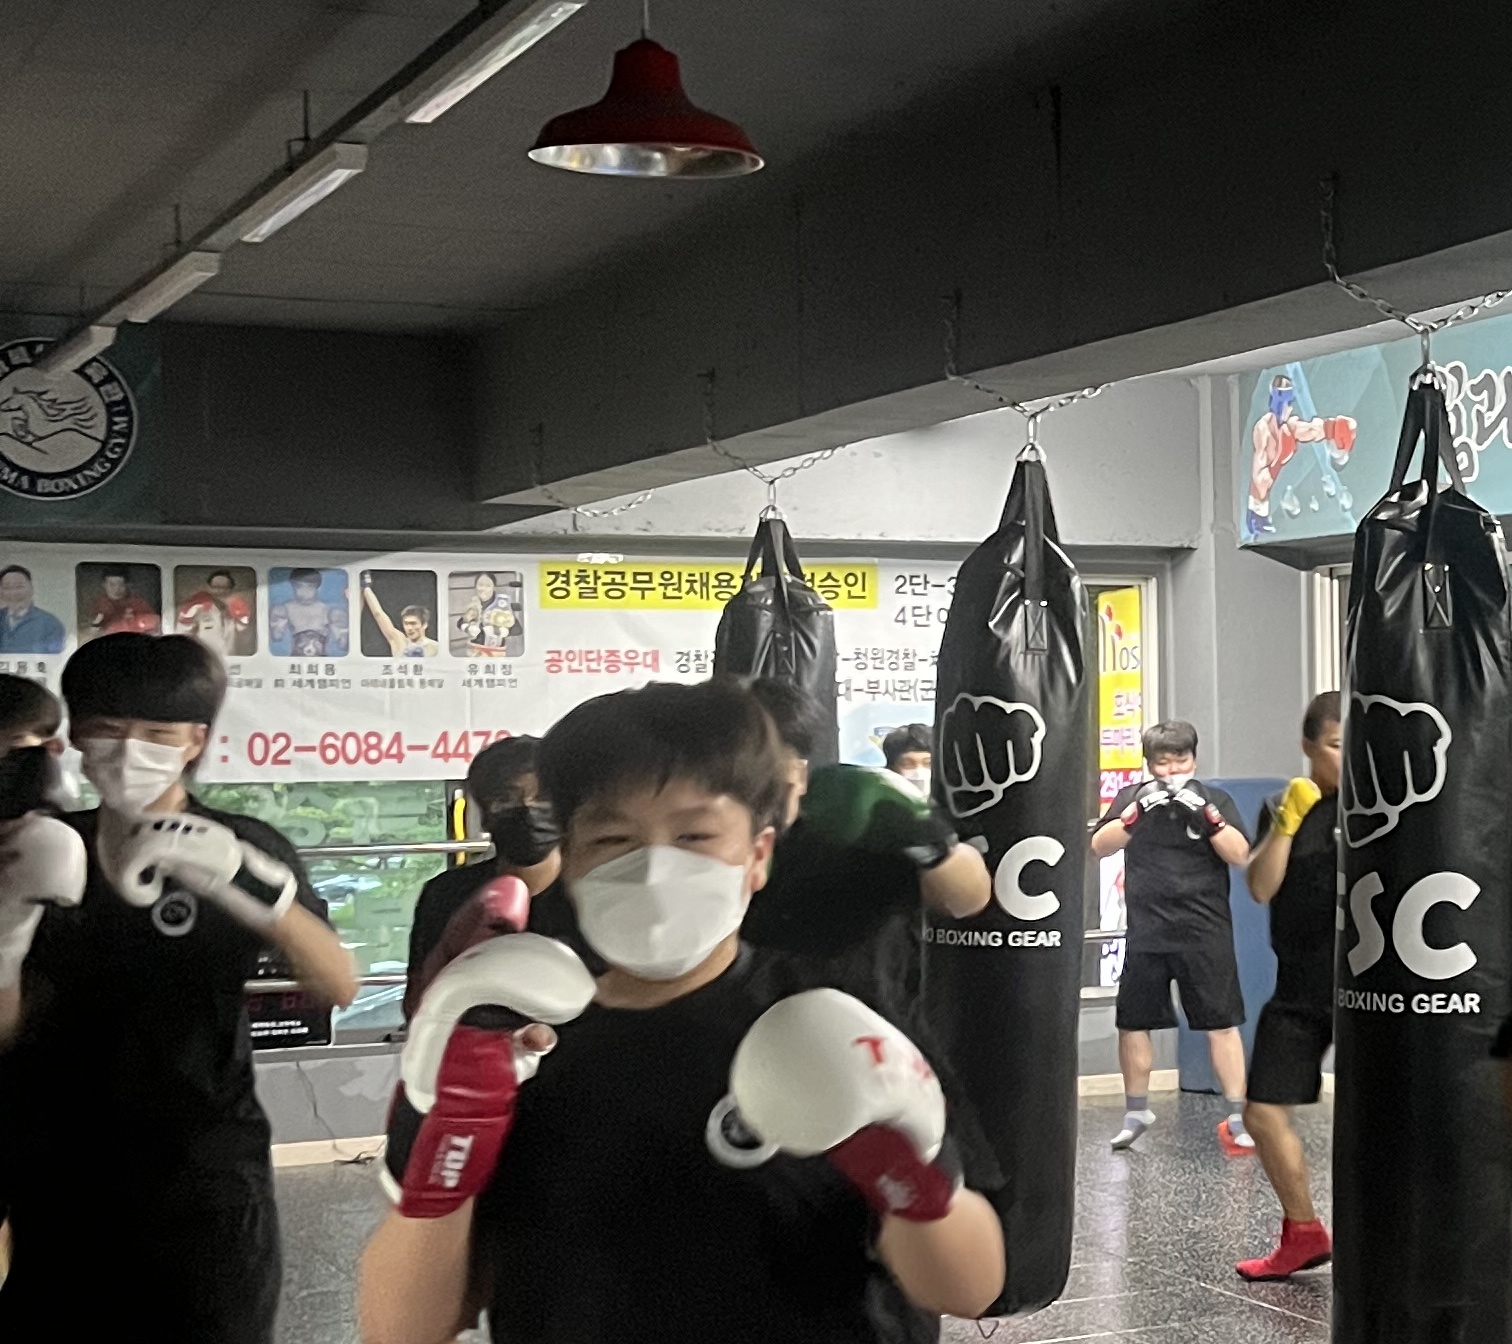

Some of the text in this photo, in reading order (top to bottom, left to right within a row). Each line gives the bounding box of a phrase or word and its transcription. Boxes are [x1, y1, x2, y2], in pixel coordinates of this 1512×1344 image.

[544, 649, 660, 674] 공인단증우대
[675, 649, 715, 674] 경찰
[936, 929, 1003, 948] BOXING
[1007, 930, 1062, 947] GEAR
[1337, 871, 1482, 981] SC
[1338, 988, 1482, 1014] BOXING GEAR
